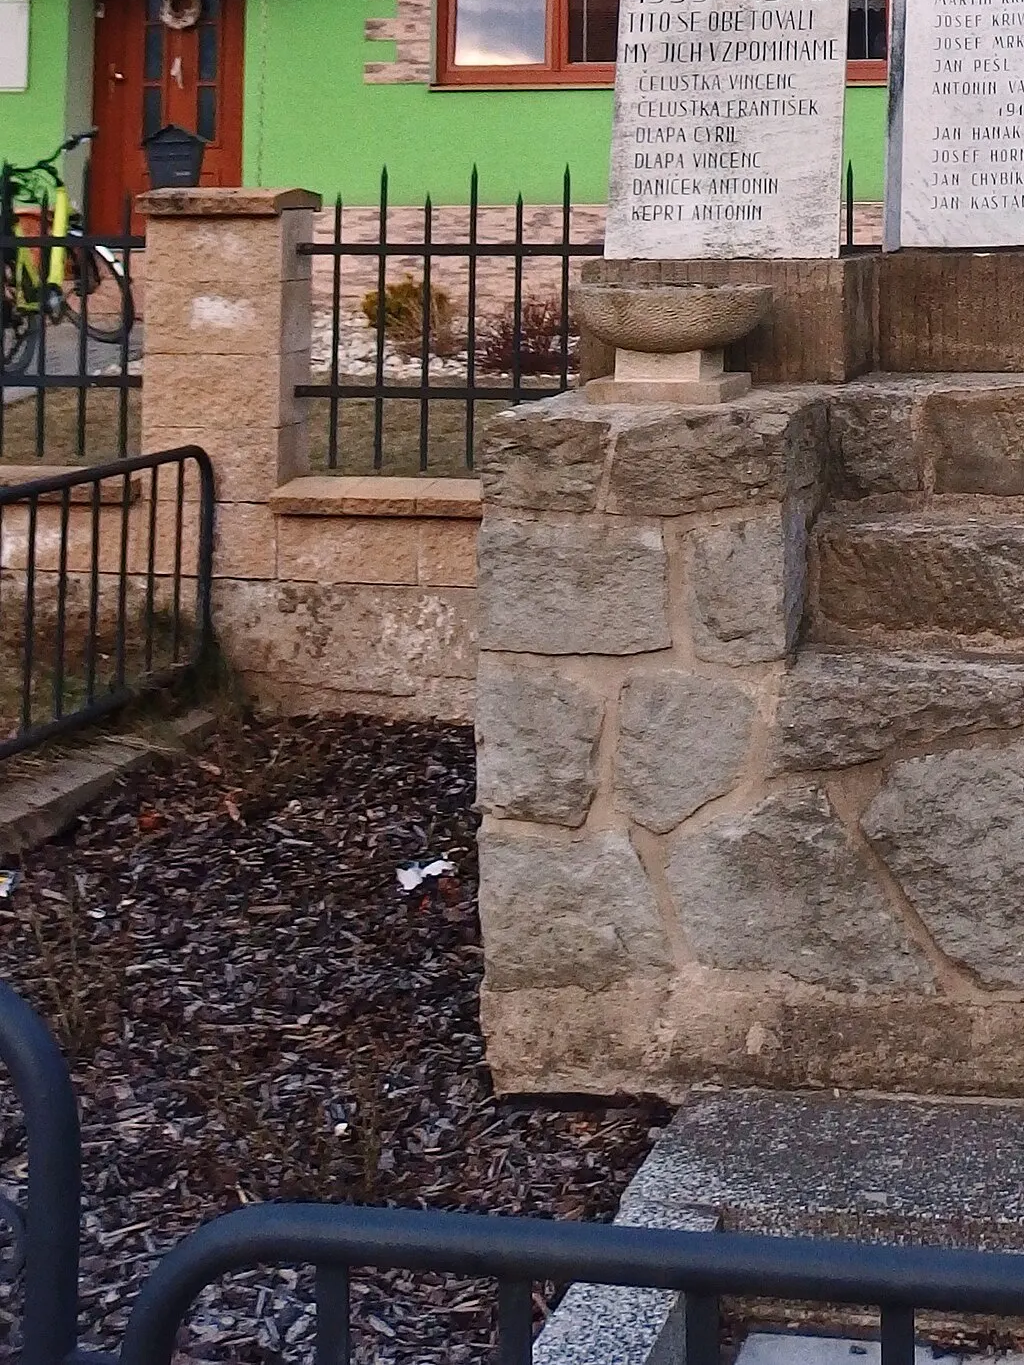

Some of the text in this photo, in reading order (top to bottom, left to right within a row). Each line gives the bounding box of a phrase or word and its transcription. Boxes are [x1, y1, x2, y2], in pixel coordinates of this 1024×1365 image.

[628, 4, 814, 33] TITO SE OBĚTOVALI
[934, 14, 983, 28] JOSEF
[624, 43, 648, 63] MY
[658, 42, 702, 63] JICH
[934, 37, 982, 51] JOSEF
[933, 59, 963, 73] JAN
[639, 69, 799, 92] ČELUSTKA VINCENC
[638, 94, 819, 118] ČELUSTKA FRANTIŠEK
[635, 125, 738, 143] DLAPA CYRIL
[932, 127, 961, 141] JAN
[634, 151, 762, 169] DLAPA VINCENC
[932, 149, 981, 163] JOSEF
[709, 172, 778, 194] ANTONÍN
[932, 173, 960, 187] JAN
[631, 199, 762, 222] KEPRT ANTONÍN
[931, 196, 960, 210] JAN
